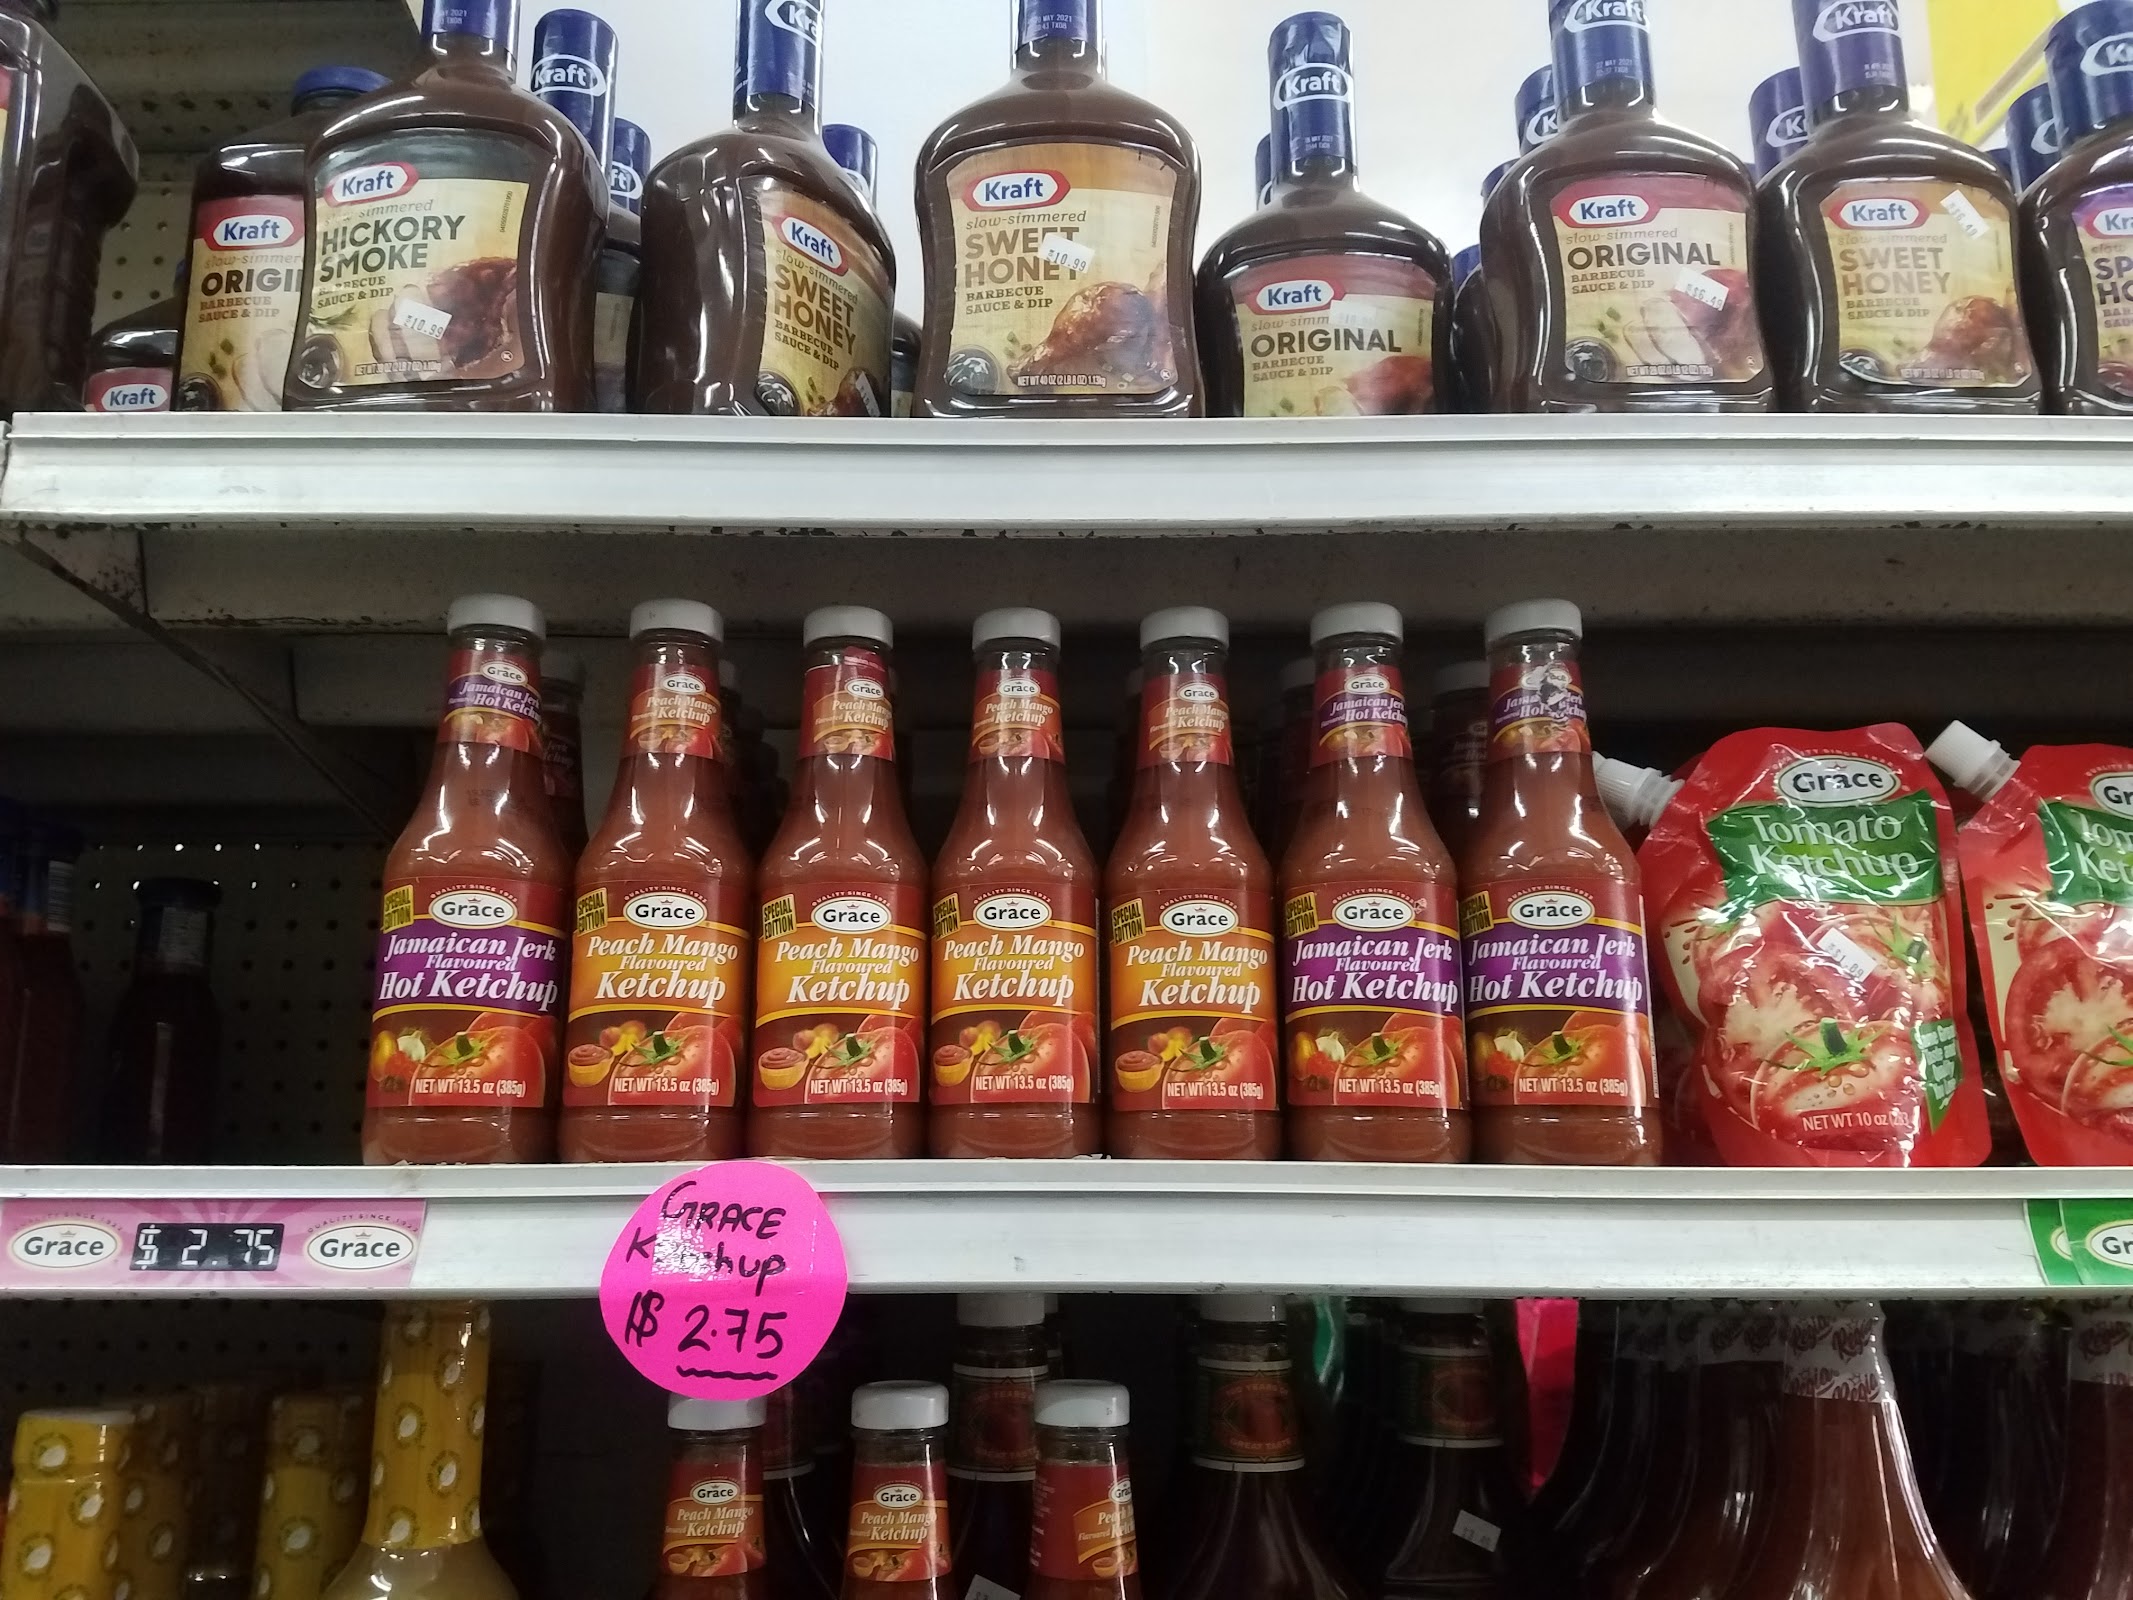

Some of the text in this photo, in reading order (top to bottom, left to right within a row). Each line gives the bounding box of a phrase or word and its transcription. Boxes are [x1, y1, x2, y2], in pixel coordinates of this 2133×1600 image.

[1056, 14, 1072, 22] 2021
[1585, 1, 1645, 20] Kraft
[1834, 3, 1896, 29] Kraft
[534, 64, 587, 88] Kraft
[1285, 71, 1341, 94] Kraft
[341, 169, 395, 198] Kraft
[984, 177, 1044, 202] Kraft
[965, 210, 1087, 231] slow-simmered
[1580, 199, 1638, 221] Kraft
[1851, 203, 1908, 222] Kraft
[223, 219, 281, 241] Kraft
[321, 214, 466, 256] HICKORY
[1565, 227, 1679, 245] slow-simmered
[791, 221, 834, 263] Kraft
[319, 242, 428, 284] SMOKE
[1567, 241, 1721, 270] ORIGINAL
[1839, 246, 1944, 272] SWEET
[200, 267, 303, 297] ORIGI
[1570, 268, 1646, 284] BARBECUE
[1842, 271, 1951, 297] HONEY
[774, 262, 855, 328] SWEET
[966, 285, 1044, 302] BARBECUE
[1267, 284, 1323, 307] Kraft
[1571, 279, 1656, 295] SAUCE DIP
[200, 296, 272, 311] BARBECUE
[965, 298, 1054, 315] SAUCE DIP
[198, 309, 239, 323] SAUCE
[774, 292, 856, 357] HONEY
[774, 318, 834, 357] BARBECUE
[1251, 327, 1403, 358] ORIGINAL
[1252, 355, 1325, 371] BARBECUE
[1252, 366, 1334, 383] SAUCE DIP
[109, 387, 156, 406] Kraft
[487, 664, 523, 682] Grace
[459, 681, 523, 700] Jamaican
[667, 679, 701, 691] Grace
[851, 684, 882, 697] Grace
[1003, 684, 1036, 693] Grace
[1183, 689, 1215, 699] Grace
[1350, 681, 1385, 690] Grace
[473, 692, 500, 707] Hot
[1329, 696, 1388, 717] Jamaican
[657, 706, 711, 727] Ketchup
[994, 711, 1047, 727] Ketchup
[1177, 715, 1225, 732] Ketchup
[1792, 771, 1884, 793] Grace
[1742, 813, 1903, 845] Tomato
[1749, 843, 1920, 880] Ketchup
[441, 901, 506, 918] Grace
[635, 904, 696, 920] Grace
[764, 897, 793, 922] SPECIAL
[822, 908, 881, 923] Grace
[983, 906, 1041, 920] Grace
[1112, 902, 1142, 926] SPECIAL
[1171, 912, 1229, 927] Grace
[1343, 905, 1404, 921] Grace
[1519, 904, 1583, 918] Grace
[764, 918, 794, 940] EDITION
[1114, 920, 1143, 944] EDITION
[383, 932, 556, 962] Jamaican Jerk
[586, 932, 739, 965] Peach Mango
[774, 936, 919, 968] Peach Mango
[943, 933, 1085, 963] Peach Mango
[1126, 940, 1268, 969] Peach Mango
[1292, 934, 1453, 967] Jamaican Jerk
[1468, 934, 1636, 966] Jamaican Jerk
[424, 954, 518, 972] Flavoured
[619, 955, 708, 972] Flavoured
[810, 959, 893, 974] Flavoured
[973, 956, 1055, 972] Flavoured
[1161, 963, 1242, 977] Flavoured
[1334, 957, 1421, 973] Flavoured
[1511, 956, 1602, 972] Flavoured
[378, 969, 558, 1012] Hot Ketchup
[594, 970, 726, 1009] Ketchup
[786, 973, 910, 1011] Ketchup
[952, 970, 1075, 1007] Ketchup
[1138, 976, 1261, 1014] Ketchup
[1291, 971, 1459, 1012] Hot Ketchup
[1469, 970, 1643, 1010] Hot Ketchup
[415, 1078, 526, 1098] NET WT 13.5 (385g)
[975, 1075, 1075, 1093] NET WT 13.5 (385g)
[1338, 1078, 1442, 1099] NET WT 13.5 (385g)
[1802, 1111, 1889, 1132] NET WT 10 oz
[662, 1180, 787, 1240] GRACE
[307, 1213, 354, 1234] QUALITY
[358, 1213, 391, 1222] SINCE
[23, 1236, 105, 1257] Grace
[136, 1224, 275, 1270] $ 2.75
[319, 1237, 401, 1259] Grace
[677, 1304, 788, 1359] 2.75
[697, 1487, 734, 1499] Grace
[880, 1491, 917, 1503] Grace
[677, 1506, 755, 1522] Peach Mango
[860, 1511, 937, 1527] Peach Mango
[686, 1520, 745, 1538] Ketchup
[870, 1525, 929, 1544] Ketchup
